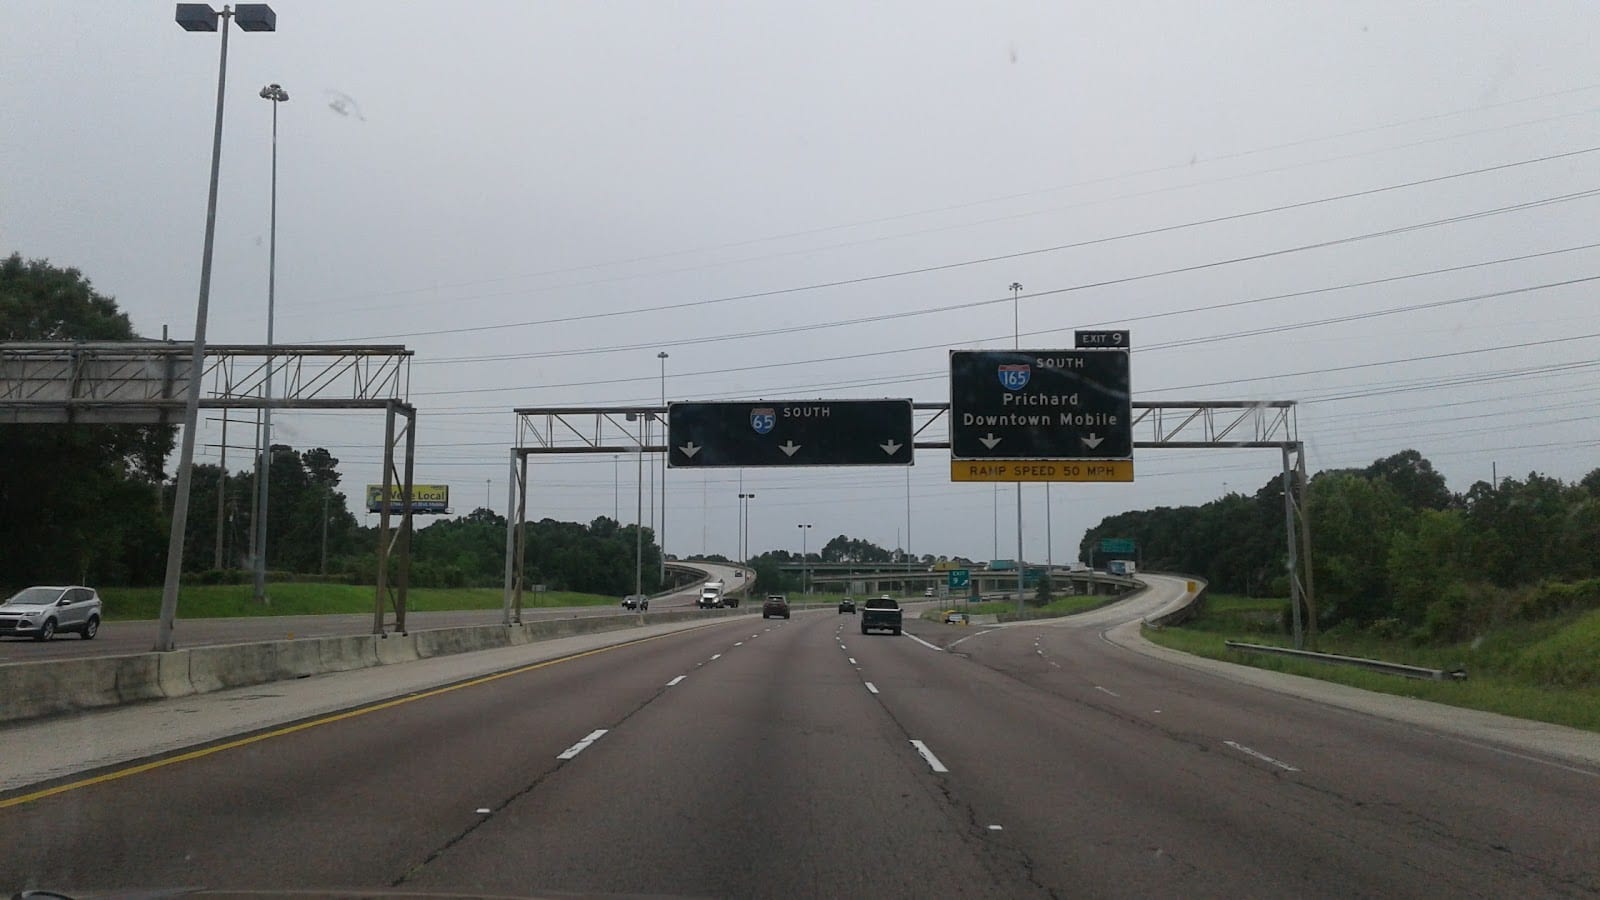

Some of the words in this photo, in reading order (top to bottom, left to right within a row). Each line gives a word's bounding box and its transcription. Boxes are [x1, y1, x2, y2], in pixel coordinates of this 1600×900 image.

[1082, 334, 1107, 343] EXIT
[1112, 332, 1122, 345] 9
[1036, 358, 1084, 368] SOUTH
[1003, 371, 1026, 385] 165
[1003, 392, 1078, 406] Prichard
[783, 407, 830, 417] SOUTH
[753, 415, 773, 429] 65
[963, 412, 1050, 426] Downtown
[1060, 412, 1117, 426] Mobile
[969, 465, 1006, 476] RAMP
[1014, 465, 1056, 476] SPEED
[1063, 465, 1080, 476] 50
[1087, 465, 1114, 476] MPH
[418, 490, 445, 500] Local
